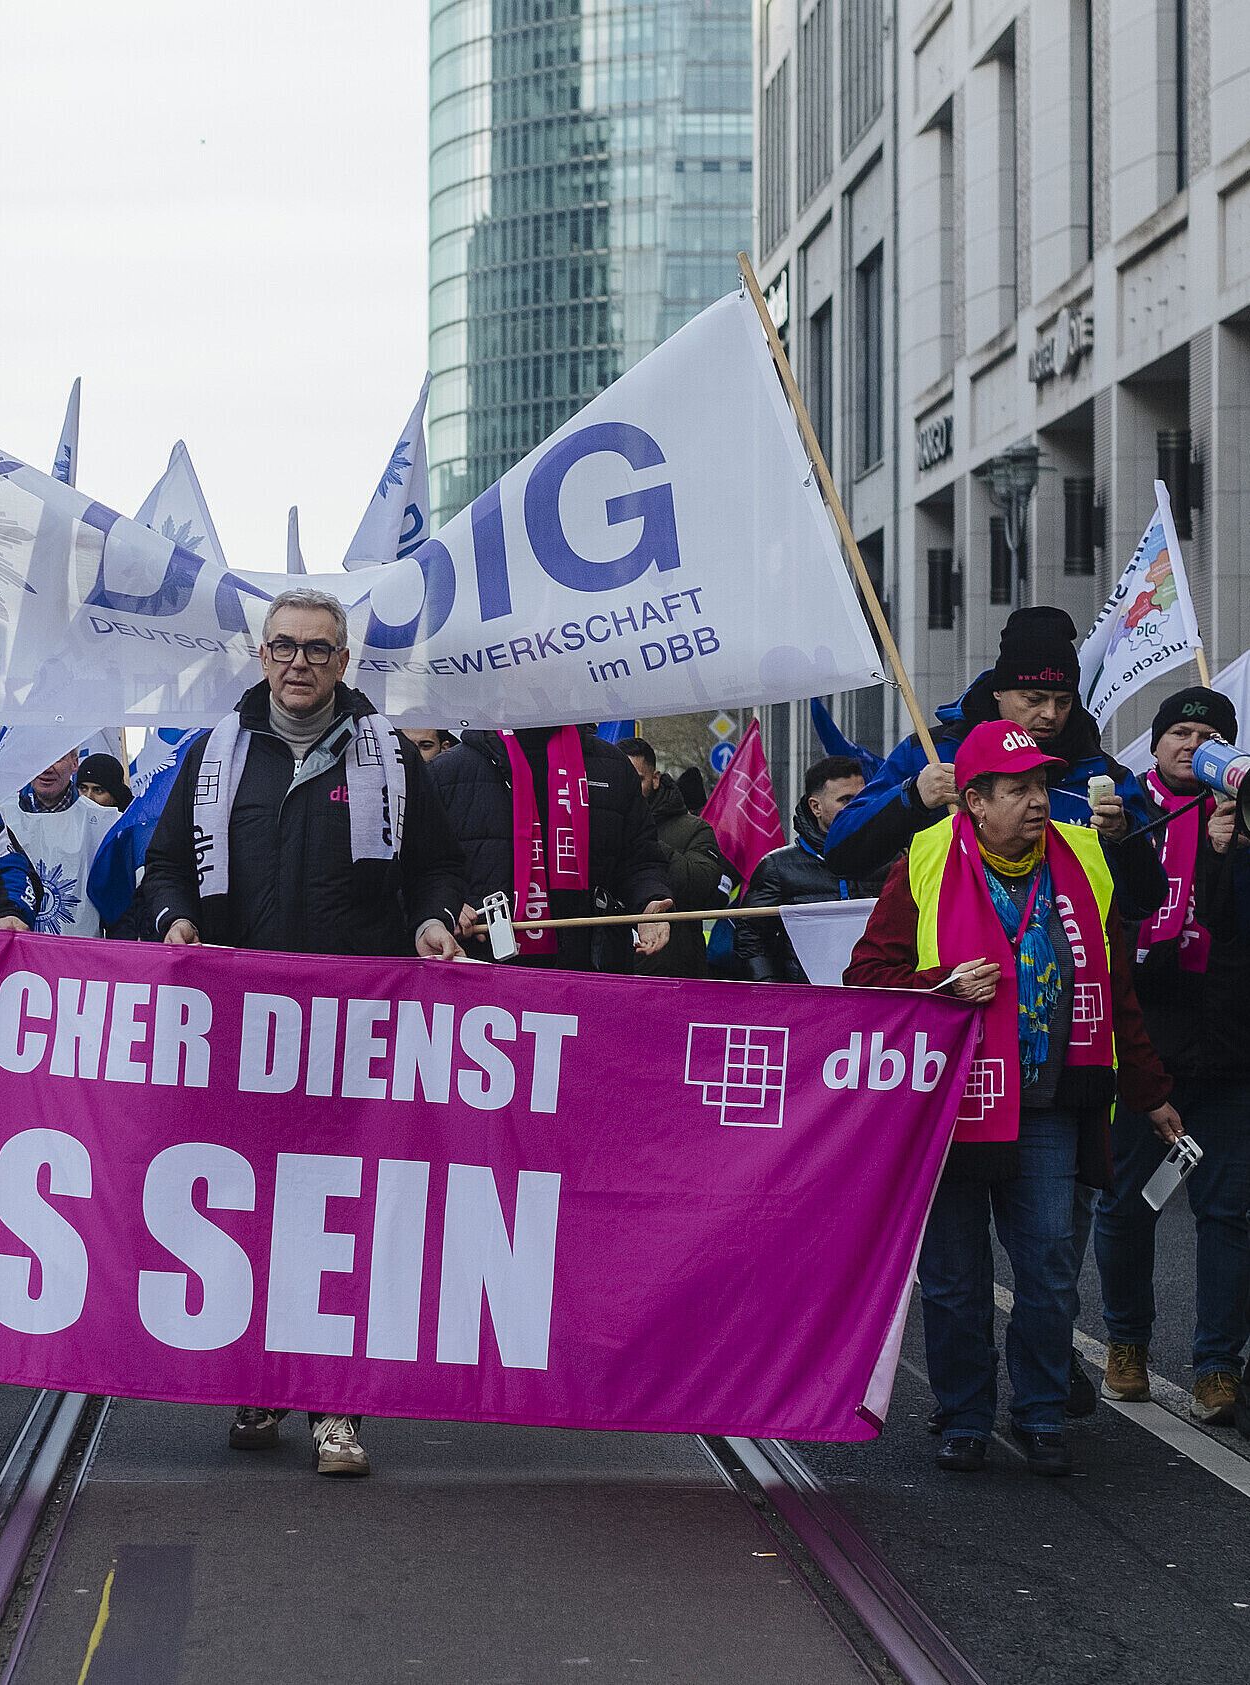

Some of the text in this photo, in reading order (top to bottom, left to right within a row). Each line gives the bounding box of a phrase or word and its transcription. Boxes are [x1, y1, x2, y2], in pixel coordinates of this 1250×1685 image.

[89, 587, 702, 675] DEUTSCHE ZEIGEWERKSCHAFT
[587, 626, 720, 683] im DBB
[1003, 731, 1037, 752] dbb
[238, 992, 579, 1114] DIENST
[822, 1030, 949, 1093] dbb
[138, 1141, 562, 1371] SEIN
